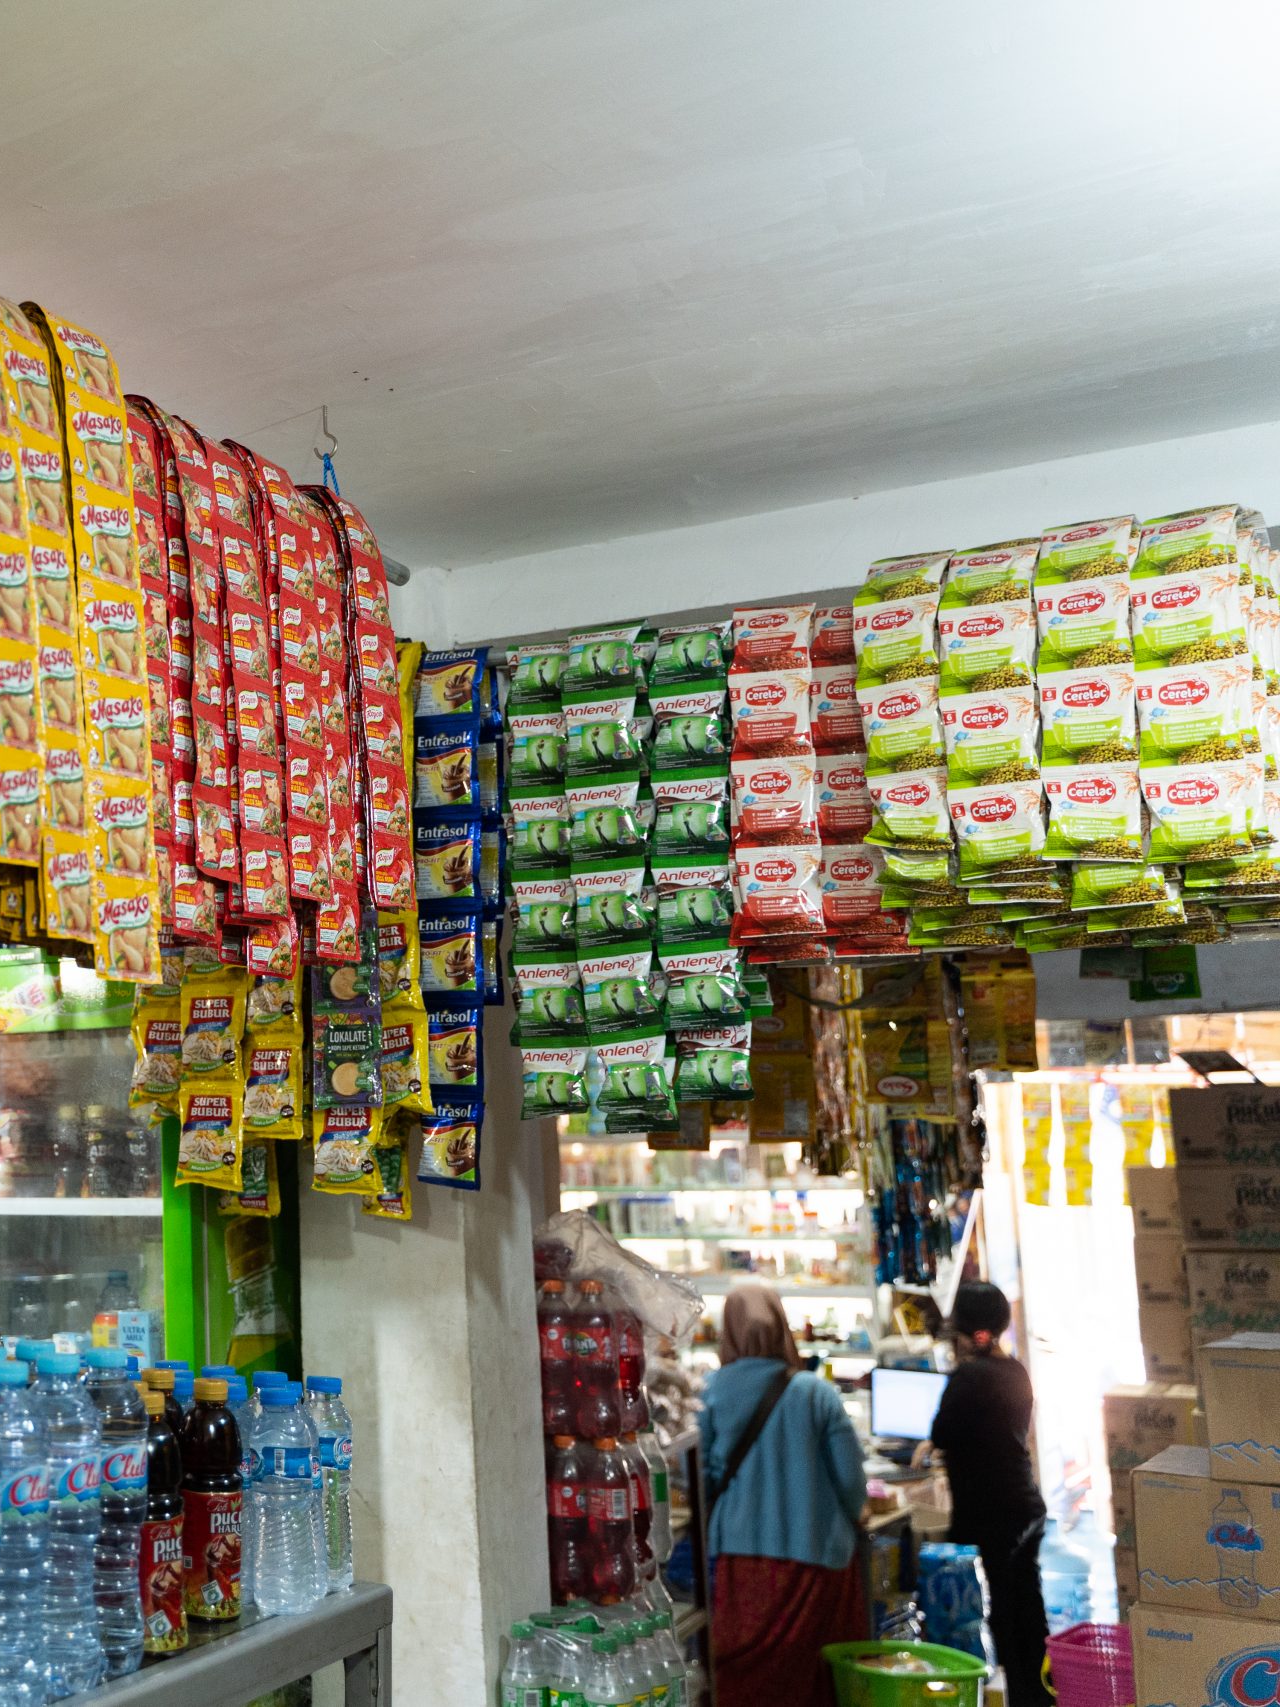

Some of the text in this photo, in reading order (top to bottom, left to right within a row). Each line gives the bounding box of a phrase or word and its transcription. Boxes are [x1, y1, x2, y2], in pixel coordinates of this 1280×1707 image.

[58, 327, 101, 350] Masako
[5, 351, 47, 377] Masako
[74, 411, 122, 434] Masako
[82, 505, 129, 525] Masako
[32, 546, 66, 568] asak
[1152, 591, 1198, 604] Cerelac
[1059, 597, 1101, 611] Cerelac
[86, 600, 135, 622] Masako
[285, 612, 301, 622] Royco
[748, 617, 786, 628] Cerelac
[872, 615, 910, 628] Cerelac
[959, 622, 1001, 633] Cerelac
[362, 638, 377, 648] Royco
[425, 649, 475, 662] Entrasol
[288, 687, 303, 696] Royco
[747, 689, 784, 701] Cerelac
[1064, 689, 1107, 701] Cerelac
[1160, 688, 1206, 700] Cerelac
[241, 695, 257, 705] Royco
[655, 699, 705, 711] Anlene
[91, 698, 142, 723] Masako
[367, 709, 382, 718] Royco
[565, 704, 612, 718] Anlene
[879, 701, 918, 715] Cerelac
[512, 718, 557, 729] Anlene
[963, 711, 1006, 724] Cerelac
[417, 732, 468, 749] Entrasol
[657, 783, 707, 796] Anlene
[751, 779, 789, 789] Cerelac
[570, 790, 615, 802] Anlene
[887, 790, 927, 801] Cerelac
[1067, 786, 1113, 798] Cerelac
[1168, 787, 1215, 799] Cerelac
[95, 795, 146, 820] Masako
[512, 801, 557, 812] Anlene
[971, 803, 1013, 817] Cerelac
[417, 824, 468, 839] Entrasol
[294, 840, 310, 851] Royco
[248, 855, 266, 866] Royco
[377, 854, 393, 863] Royco
[178, 869, 196, 880] Royco
[755, 866, 794, 877] Cerelac
[831, 865, 870, 874] Cerelac
[574, 876, 621, 887] Anlene
[658, 871, 709, 882] Anlene
[516, 884, 561, 895] Anlene
[99, 895, 149, 925] Masako
[419, 916, 470, 931] Entrasol
[379, 925, 399, 935] PER
[379, 937, 403, 947] BUR
[582, 962, 629, 974] Anlene
[666, 958, 716, 970] Anlene
[518, 968, 563, 980] Anlene
[194, 999, 228, 1009] SUPER
[192, 1009, 230, 1019] BUBUR
[428, 1009, 470, 1024] ntrasol
[330, 1031, 366, 1042] LOKALATE
[678, 1027, 731, 1040] Anlene
[255, 1050, 287, 1060] SUPER
[597, 1045, 643, 1057] Anlene
[522, 1052, 567, 1063] Anlene
[253, 1060, 287, 1071] BUBUR
[194, 1097, 228, 1107] SUPER
[191, 1107, 229, 1117] BUBUR
[328, 1117, 368, 1126] BUBUR
[122, 1326, 146, 1334] ULTRA
[104, 1452, 146, 1483] Club
[1215, 1526, 1255, 1545] Club
[1147, 1628, 1193, 1641] Indofood
